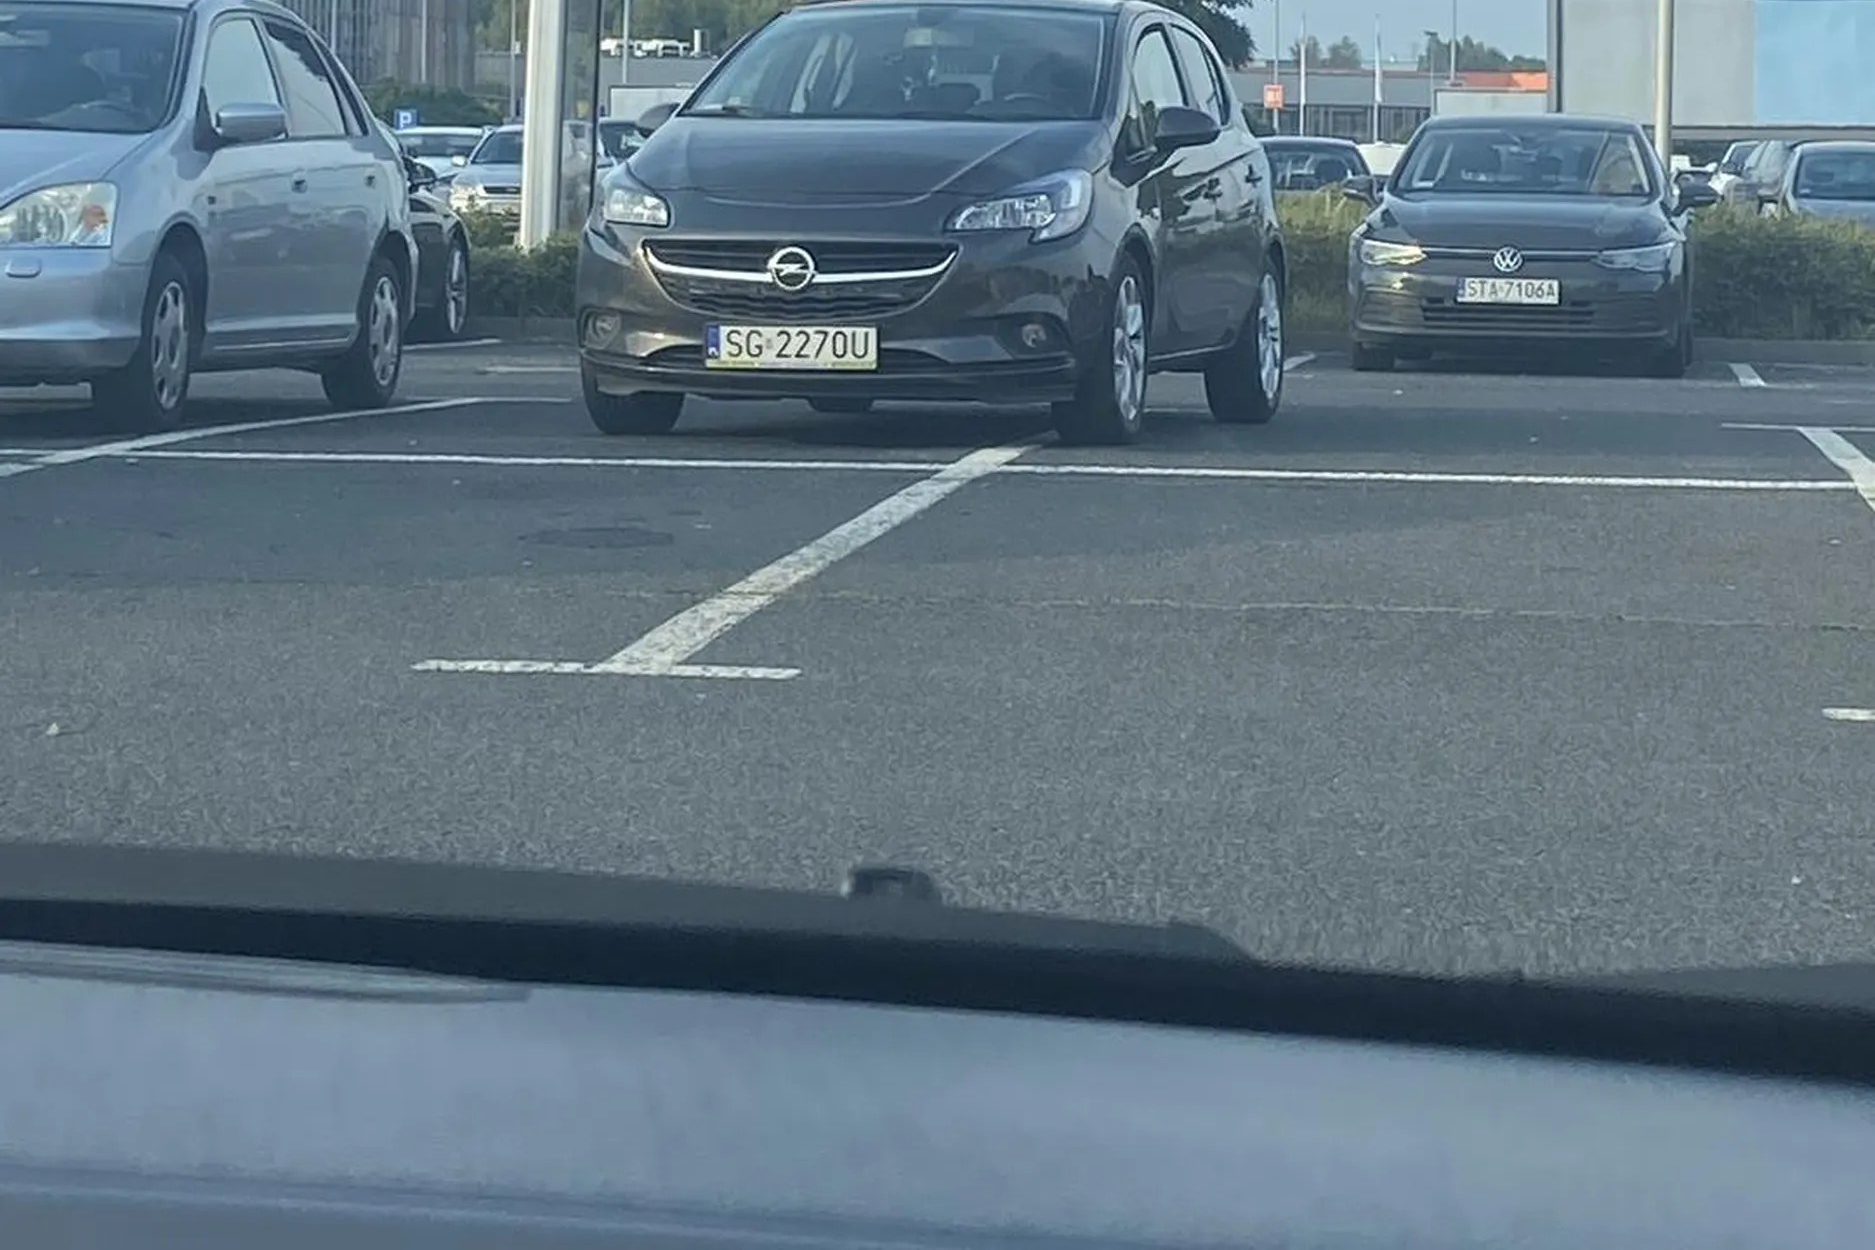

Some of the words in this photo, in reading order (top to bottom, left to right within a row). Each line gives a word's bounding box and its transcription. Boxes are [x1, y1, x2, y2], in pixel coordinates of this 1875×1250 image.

[399, 112, 411, 128] P
[1467, 280, 1497, 298] STA
[1504, 280, 1556, 299] 7106A
[726, 329, 764, 359] SG
[774, 330, 870, 360] 2270U
